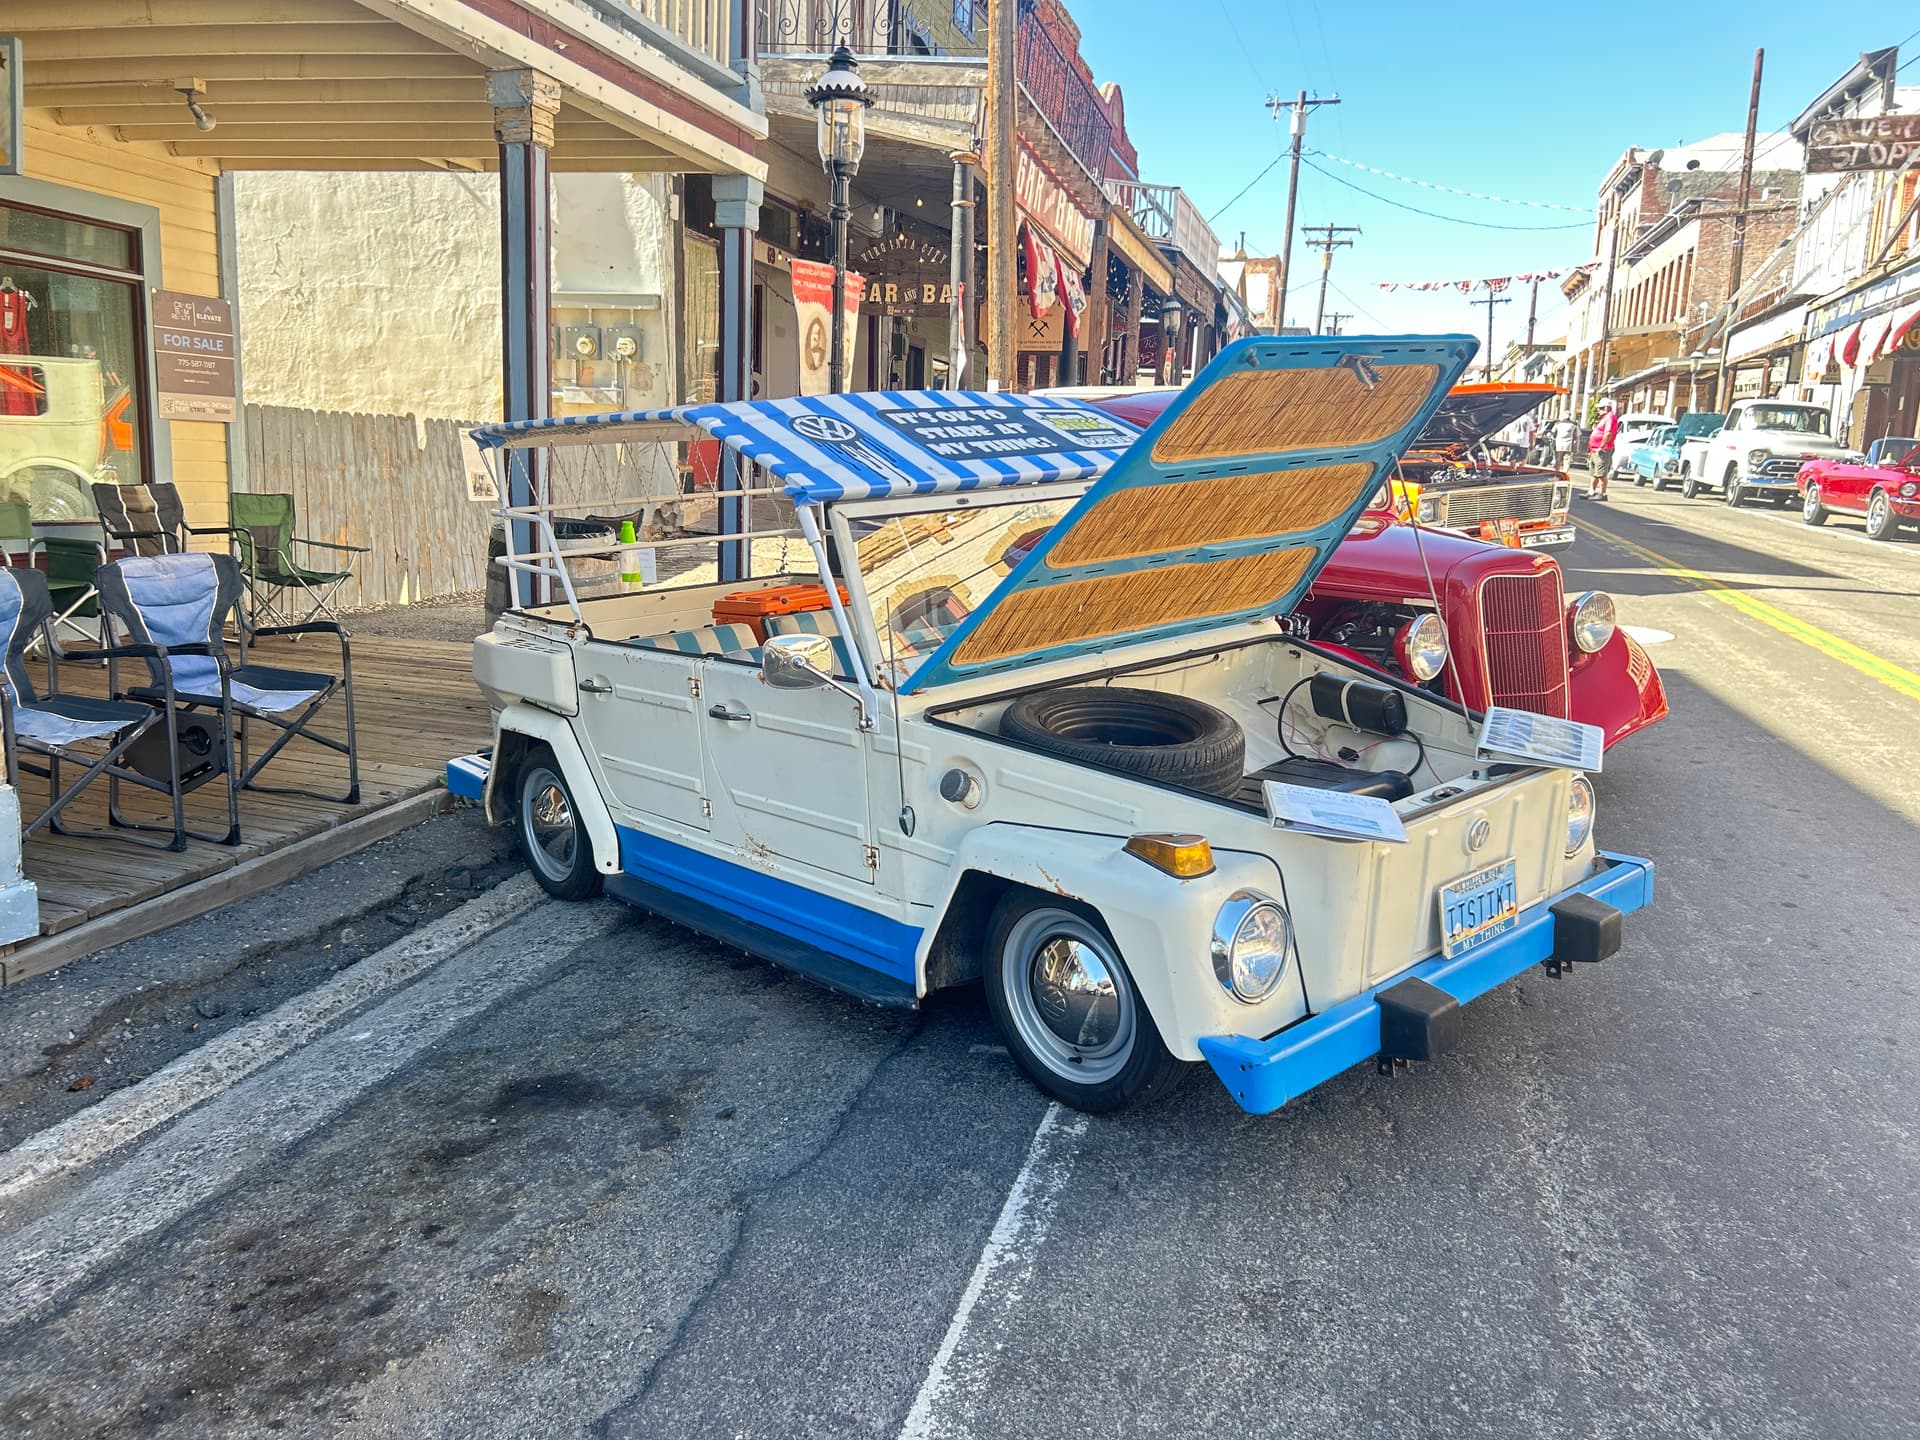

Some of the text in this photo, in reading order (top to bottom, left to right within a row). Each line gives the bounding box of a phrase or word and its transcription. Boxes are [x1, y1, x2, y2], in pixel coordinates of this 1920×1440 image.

[1016, 148, 1046, 213] GAR
[860, 238, 948, 264] VIRGINIA CITY
[903, 286, 917, 302] AND
[196, 313, 222, 322] ELEVATE
[163, 333, 224, 352] FOR SALE
[886, 409, 1008, 425] IT'S OK TO
[915, 422, 1028, 440] STARE AT
[926, 436, 1059, 456] MY THING!
[1448, 880, 1514, 938] ITSTIKI
[1462, 922, 1506, 951] MY THING
